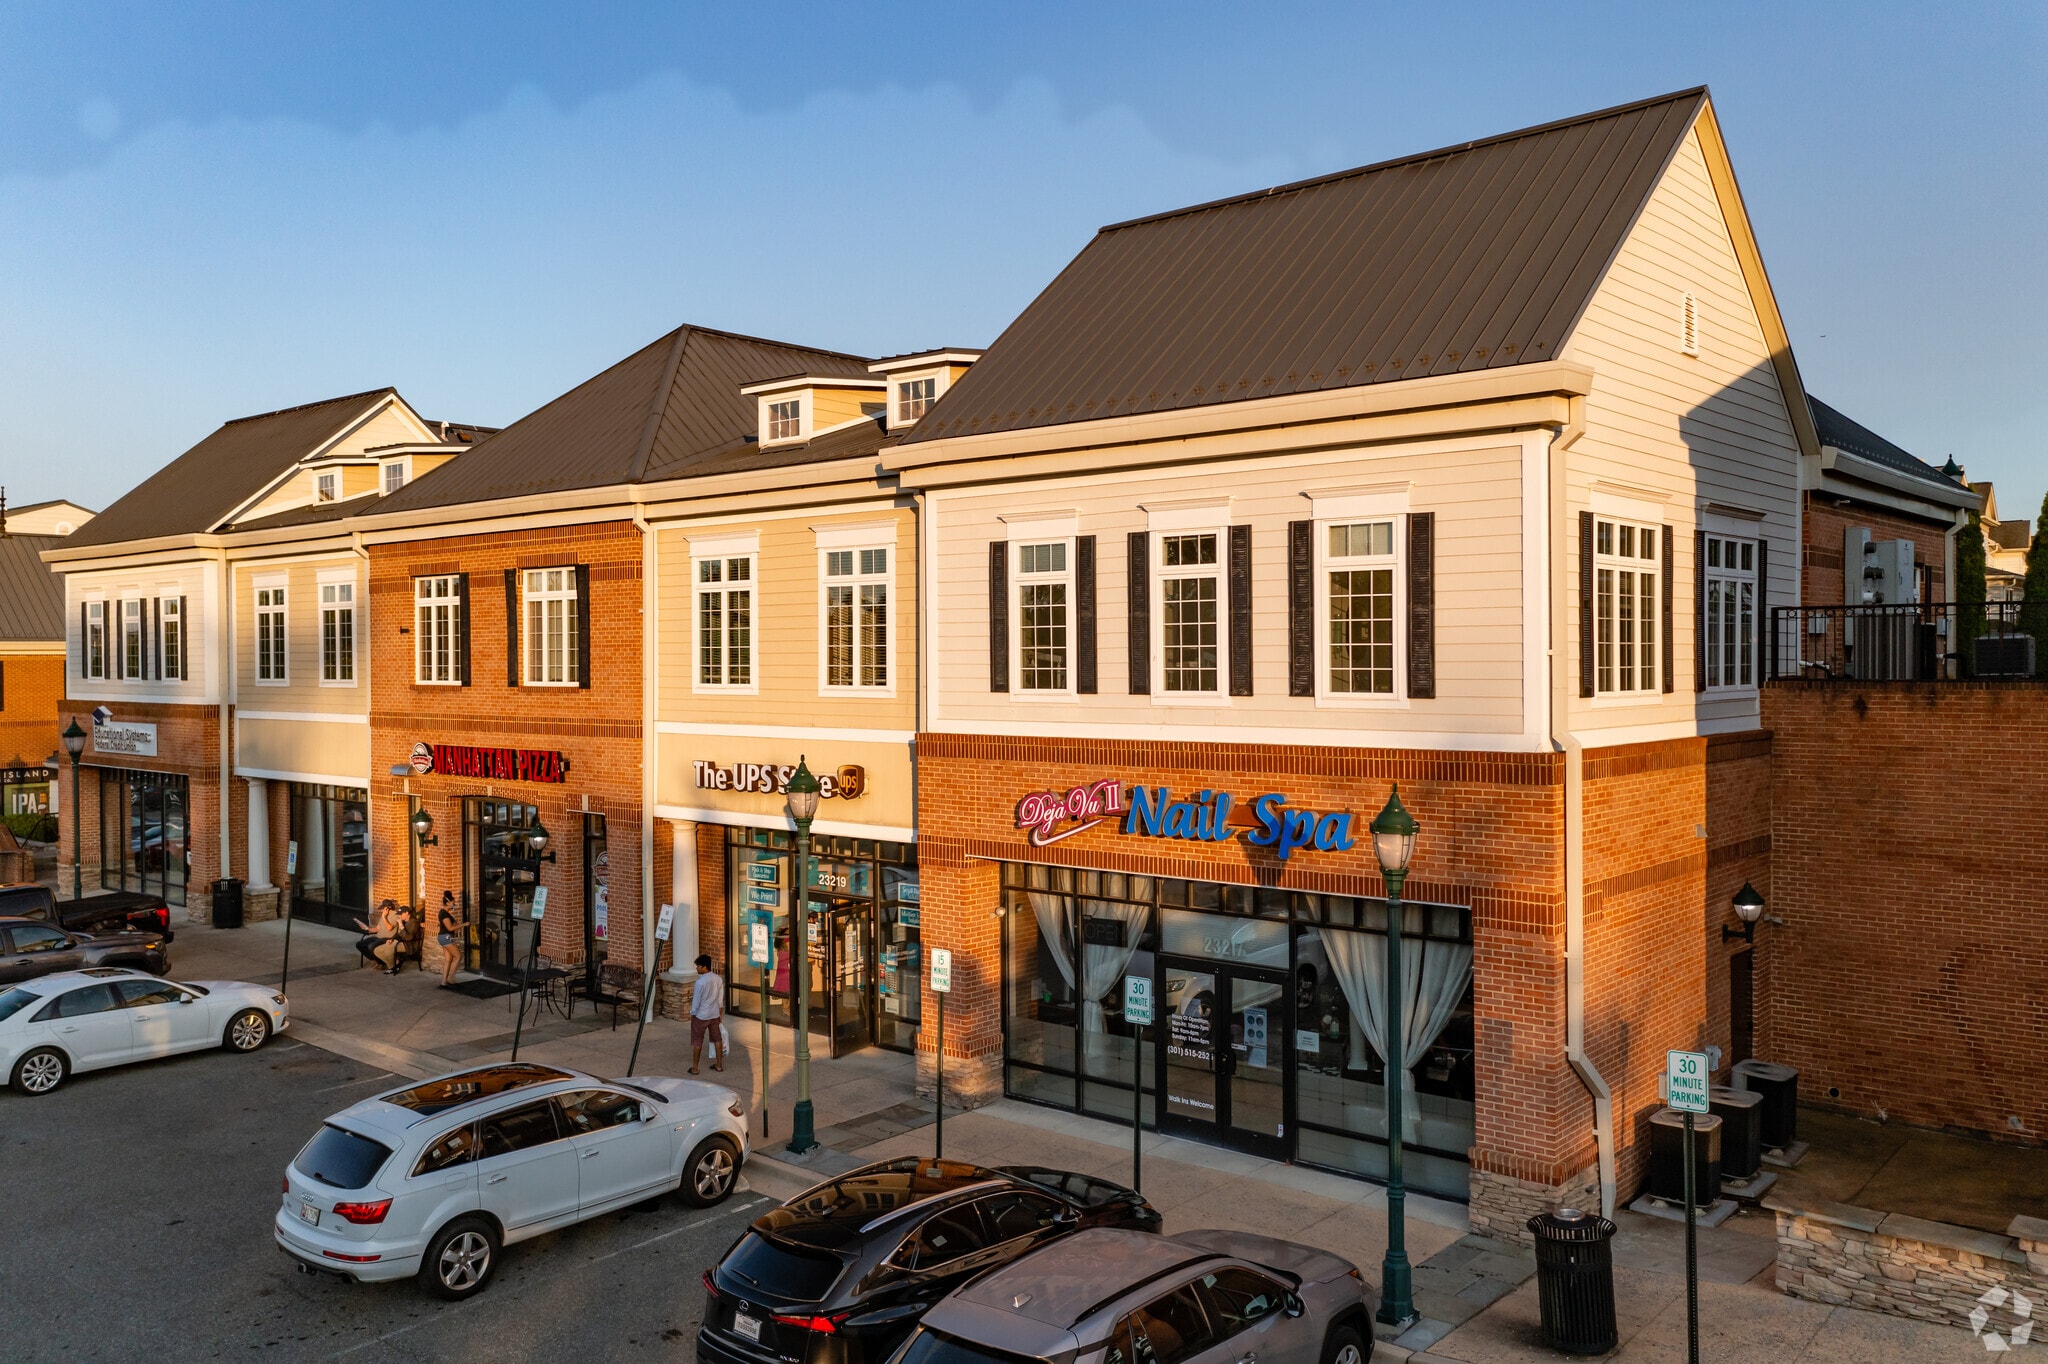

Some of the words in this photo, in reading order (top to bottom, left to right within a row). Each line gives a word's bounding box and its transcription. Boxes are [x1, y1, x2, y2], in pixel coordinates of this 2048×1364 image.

[94, 726, 124, 740] Educational
[434, 744, 514, 780] MANHATTAN
[519, 750, 562, 783] PIZZA
[3, 769, 49, 779] ISLAND
[692, 760, 728, 790] The
[732, 763, 773, 793] UPS
[840, 773, 857, 793] ups
[12, 792, 38, 815] IPA
[1068, 781, 1107, 818] Vu
[1126, 785, 1236, 841] Nail
[1248, 793, 1354, 860] Spa
[818, 874, 847, 888] 23219
[750, 890, 760, 900] We
[760, 891, 773, 901] Print
[938, 954, 945, 965] 15
[933, 967, 948, 976] MINUTE
[932, 977, 949, 987] PARKING
[1132, 982, 1145, 995] 30
[1128, 996, 1148, 1008] MINUTE
[1127, 1007, 1150, 1019] PARKING
[1167, 1045, 1184, 1057] (301)
[1679, 1058, 1697, 1075] 30
[1672, 1075, 1704, 1091] MINUTE
[1167, 1094, 1182, 1104] Walk
[1189, 1098, 1215, 1110] Welcome
[1671, 1090, 1706, 1106] PARKING
